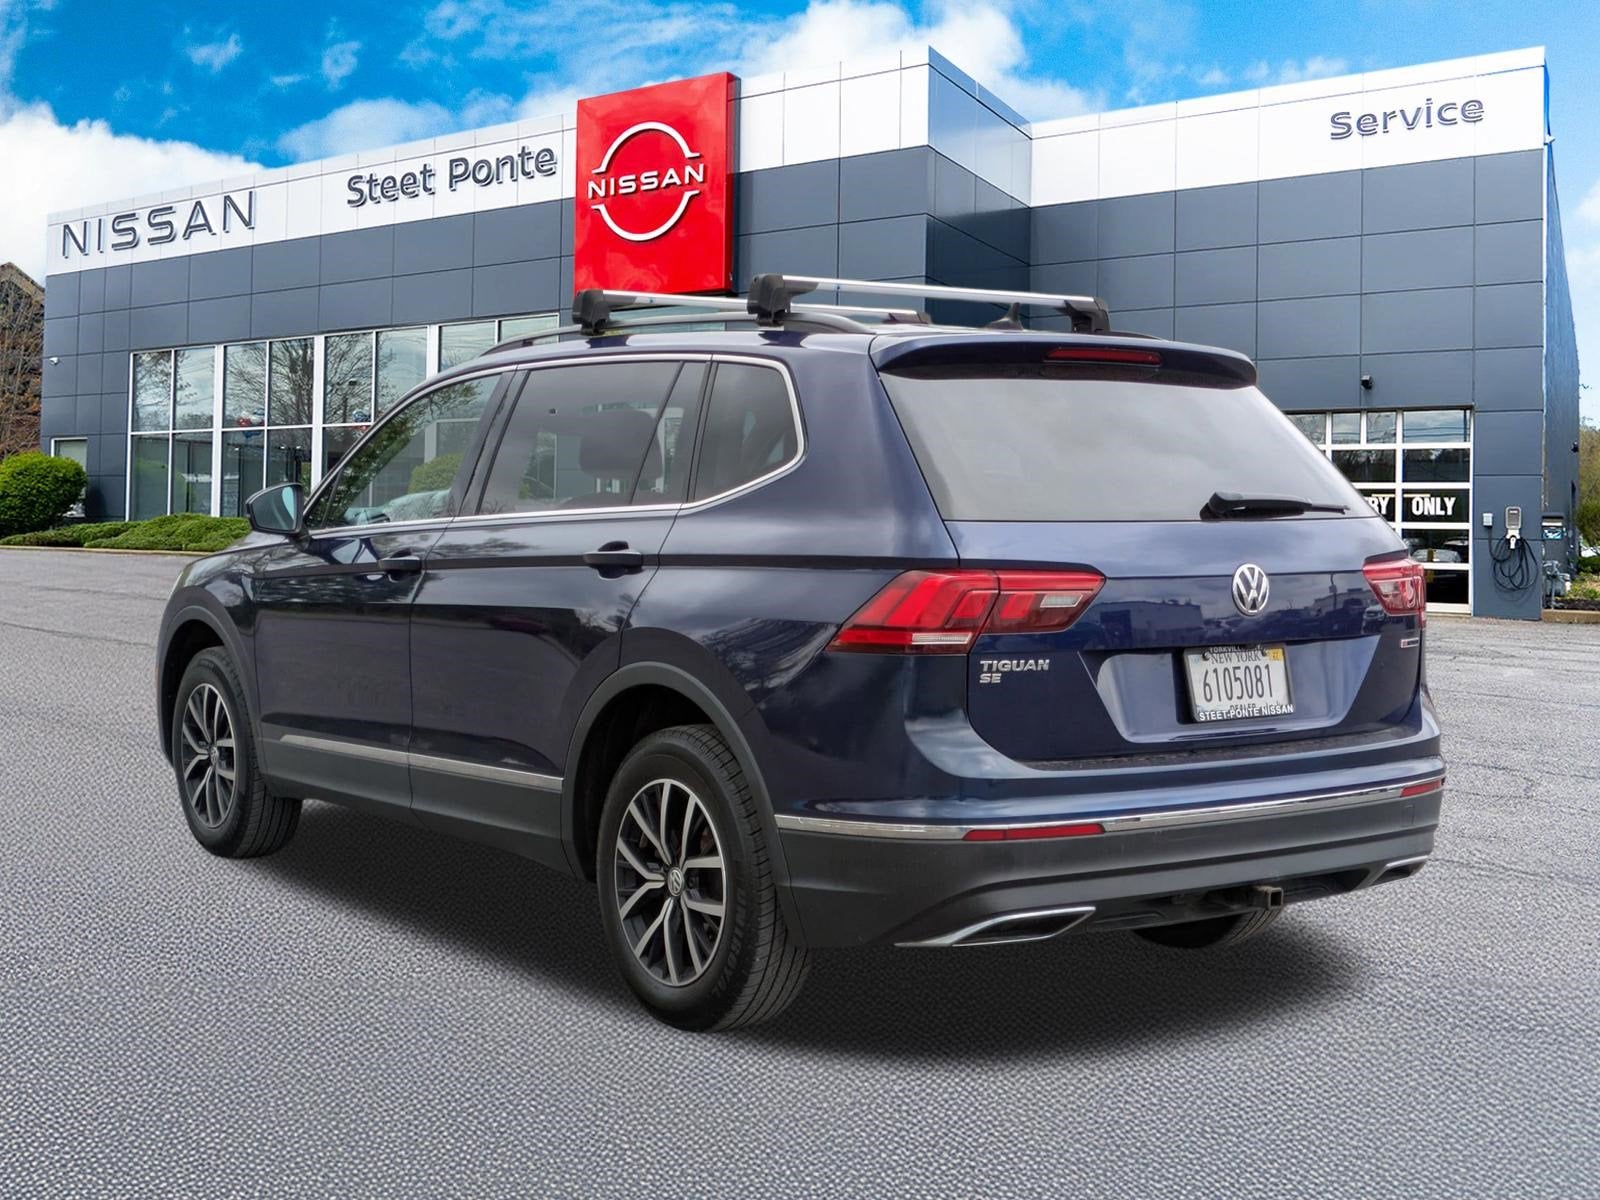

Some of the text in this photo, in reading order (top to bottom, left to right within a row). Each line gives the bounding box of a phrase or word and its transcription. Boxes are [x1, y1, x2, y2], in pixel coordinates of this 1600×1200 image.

[1330, 98, 1484, 140] Service
[347, 145, 558, 208] Steet Ponte
[587, 164, 705, 200] NISSAN
[62, 190, 256, 258] NISSAN
[1364, 496, 1456, 516] RY ONLY
[979, 659, 1050, 672] TIGUAN
[1211, 652, 1234, 664] NEW
[1235, 650, 1262, 663] YORK
[979, 672, 1002, 684] SE
[1203, 663, 1273, 702] 6105081
[1261, 704, 1295, 716] NISSAN
